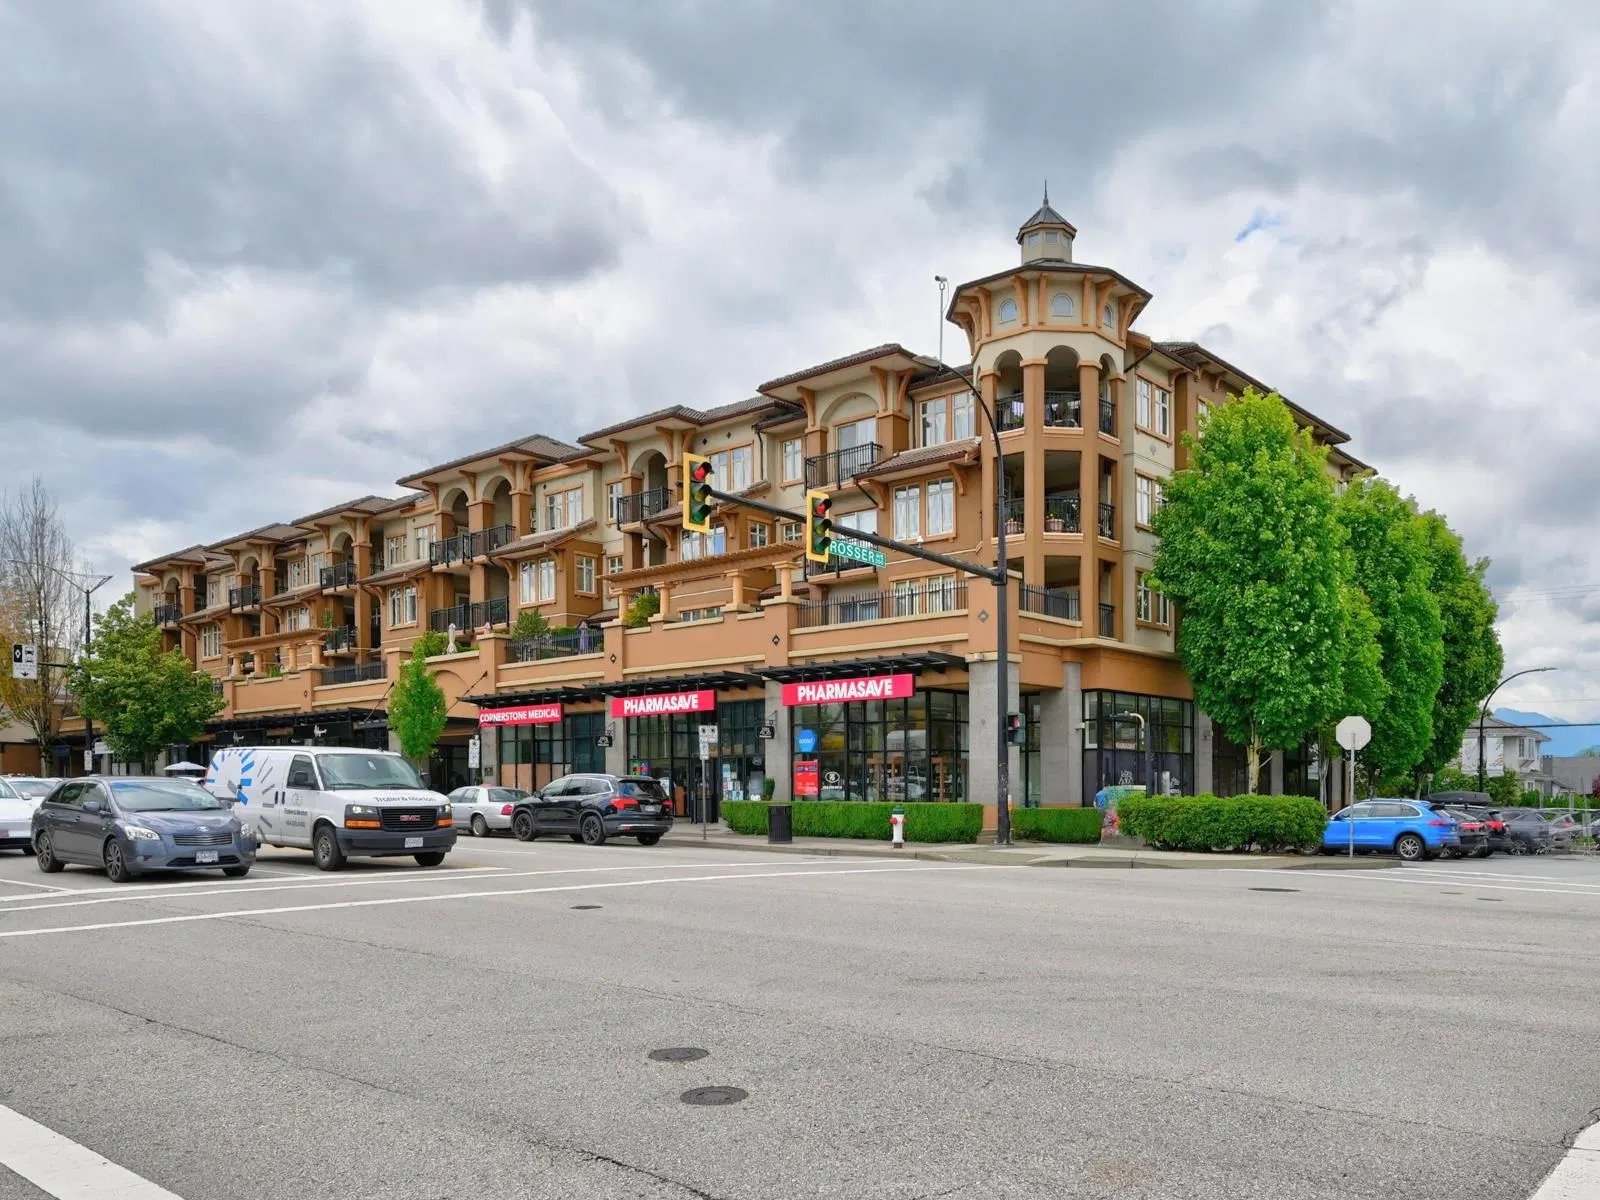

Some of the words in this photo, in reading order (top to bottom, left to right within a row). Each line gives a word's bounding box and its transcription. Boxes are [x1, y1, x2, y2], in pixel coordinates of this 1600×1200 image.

[830, 541, 875, 562] ROSSER
[797, 678, 893, 702] PHARMASAVE
[623, 694, 699, 714] PHARMASAVE
[480, 711, 527, 722] CORNERSTONE
[528, 708, 560, 719] MEDICAL
